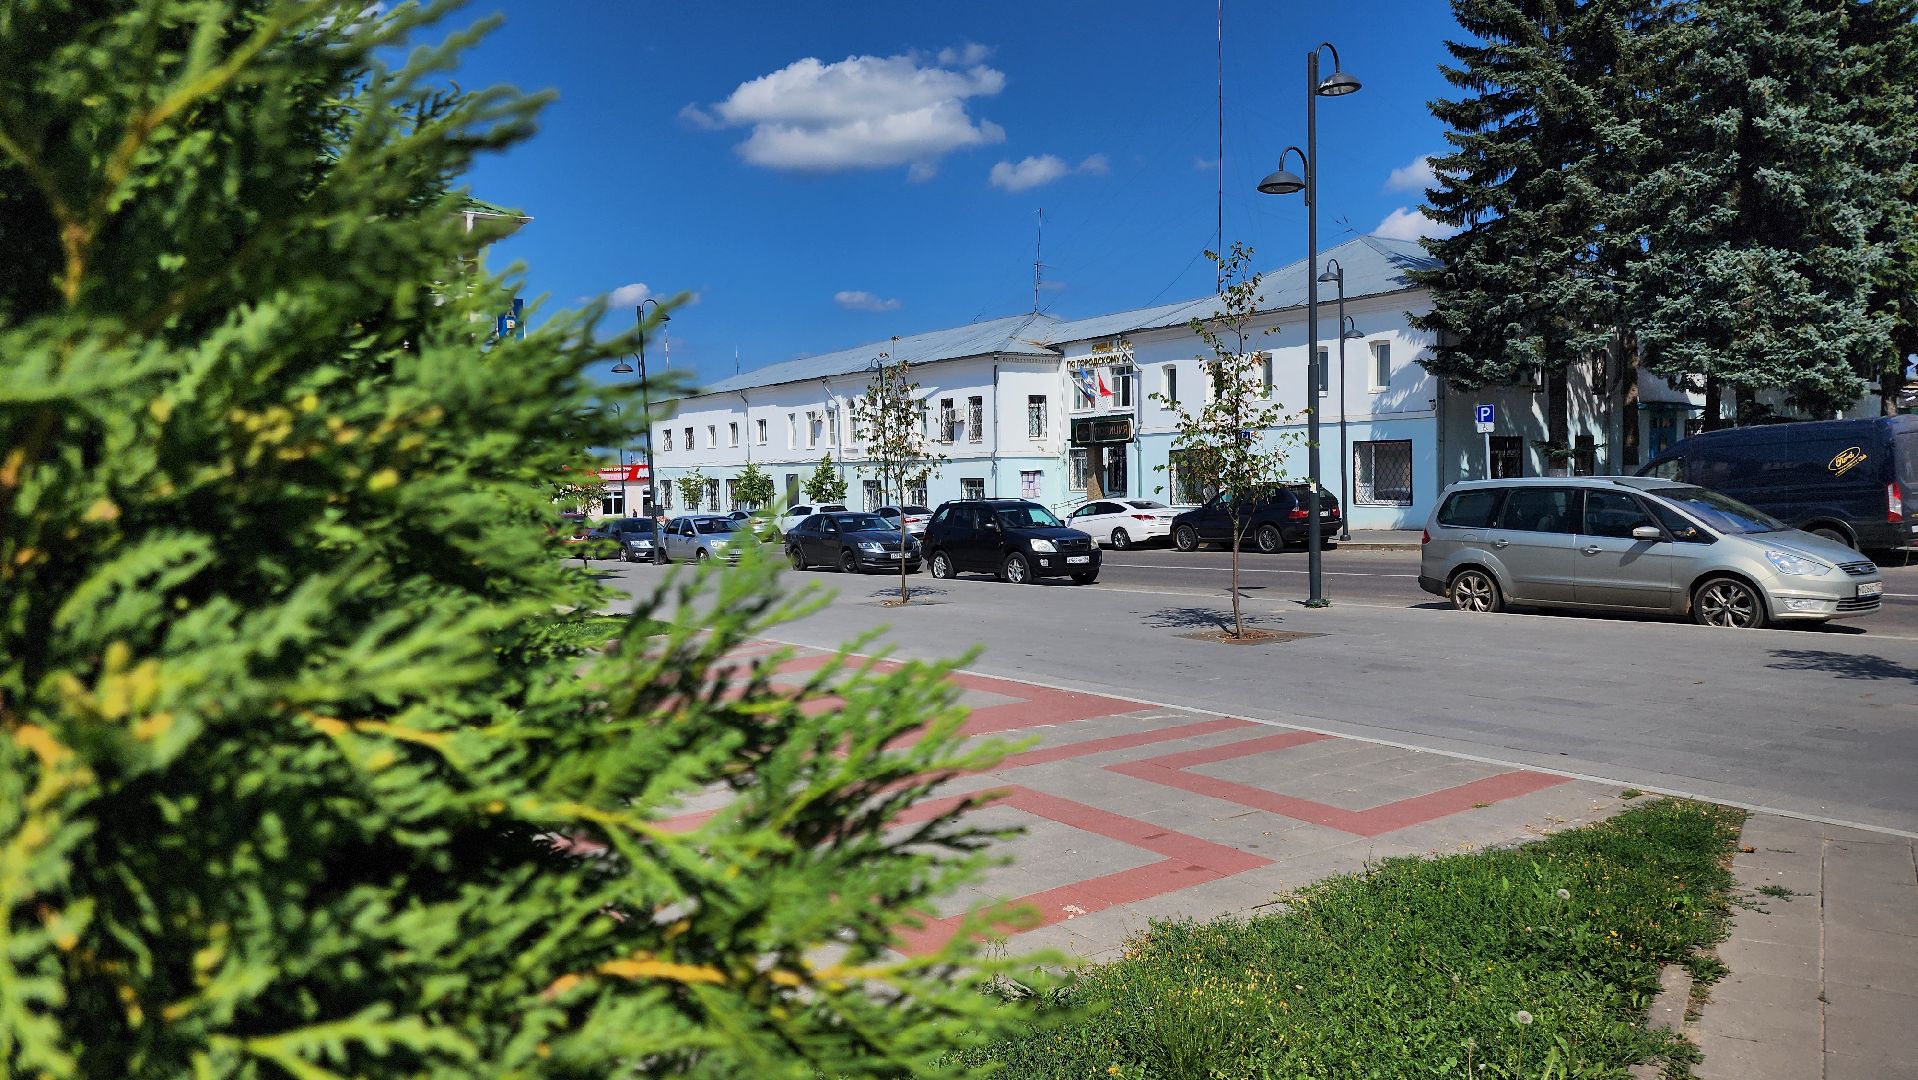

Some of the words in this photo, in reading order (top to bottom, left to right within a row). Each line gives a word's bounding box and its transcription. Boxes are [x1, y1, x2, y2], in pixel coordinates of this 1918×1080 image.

[1067, 360, 1076, 368] ПО
[1077, 354, 1121, 367] ГОРОДСКОМУ
[1481, 407, 1490, 421] P
